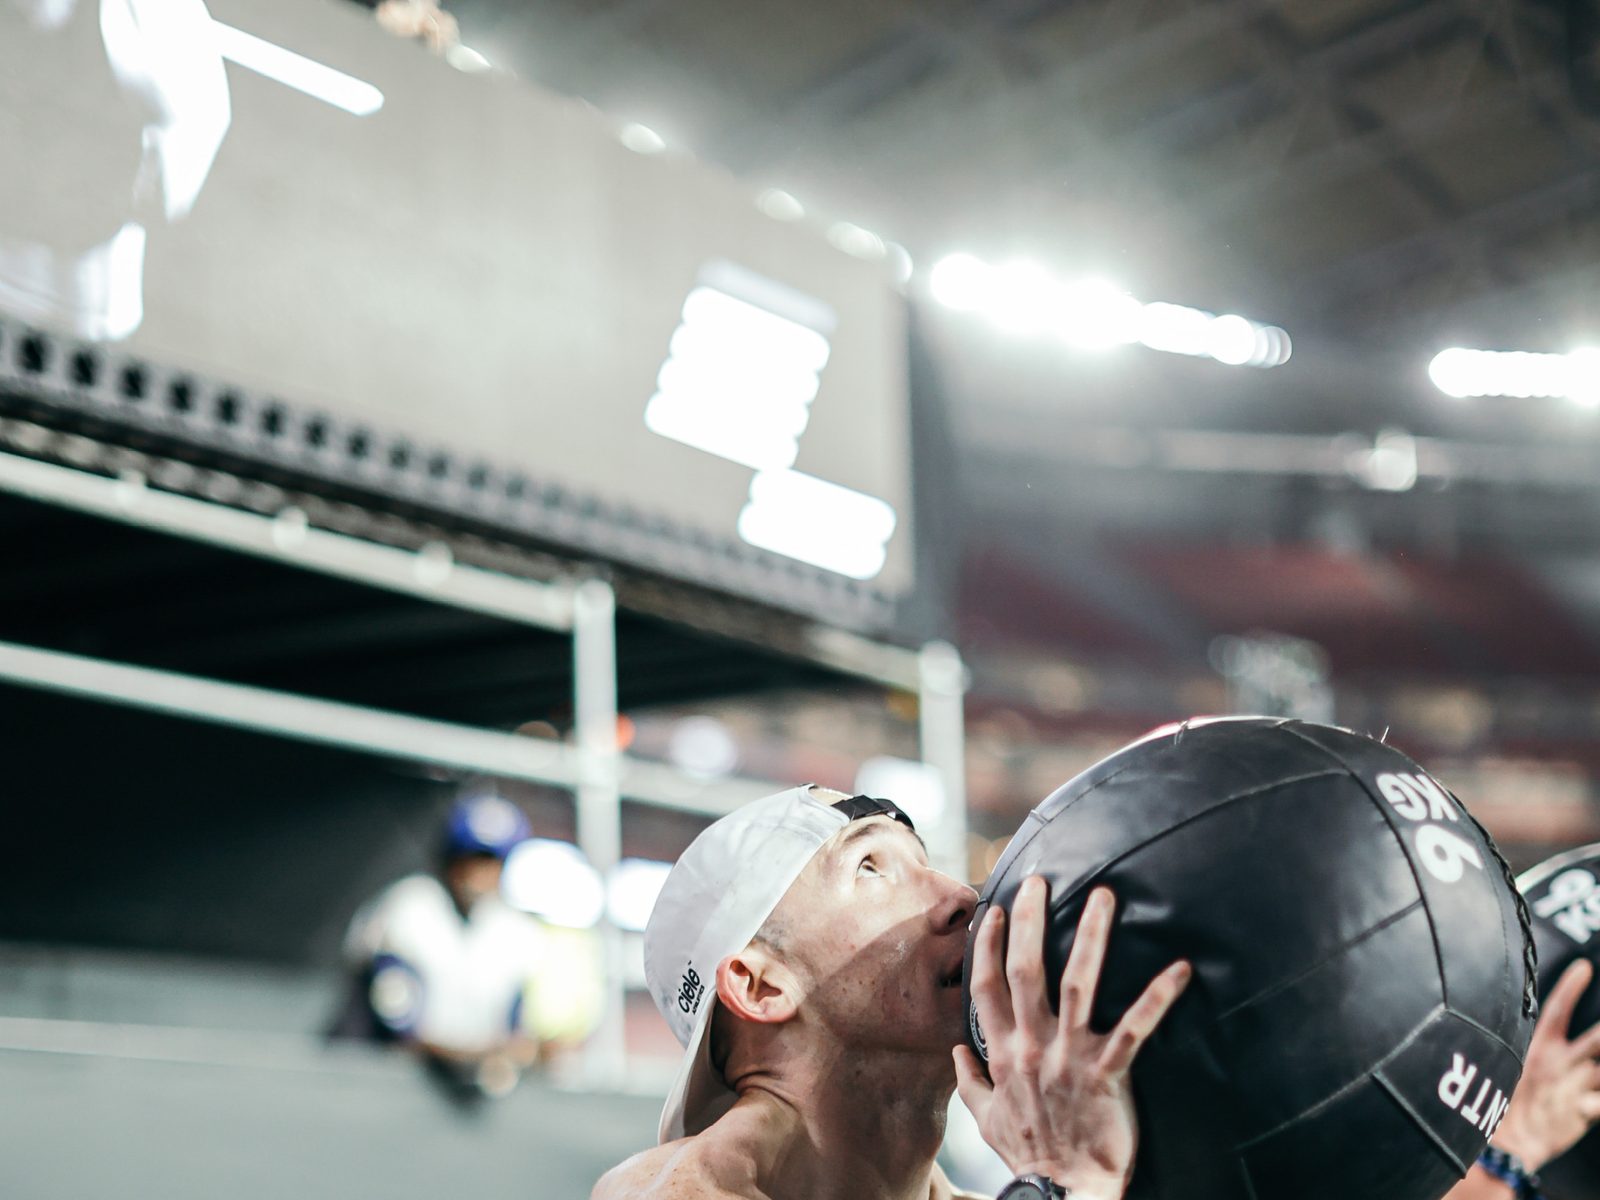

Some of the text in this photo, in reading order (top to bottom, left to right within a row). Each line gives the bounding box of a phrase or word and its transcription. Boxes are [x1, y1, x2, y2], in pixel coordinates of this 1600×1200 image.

[1375, 772, 1459, 823] KG
[678, 967, 701, 1014] ciele
[1437, 1052, 1509, 1144] NTR
